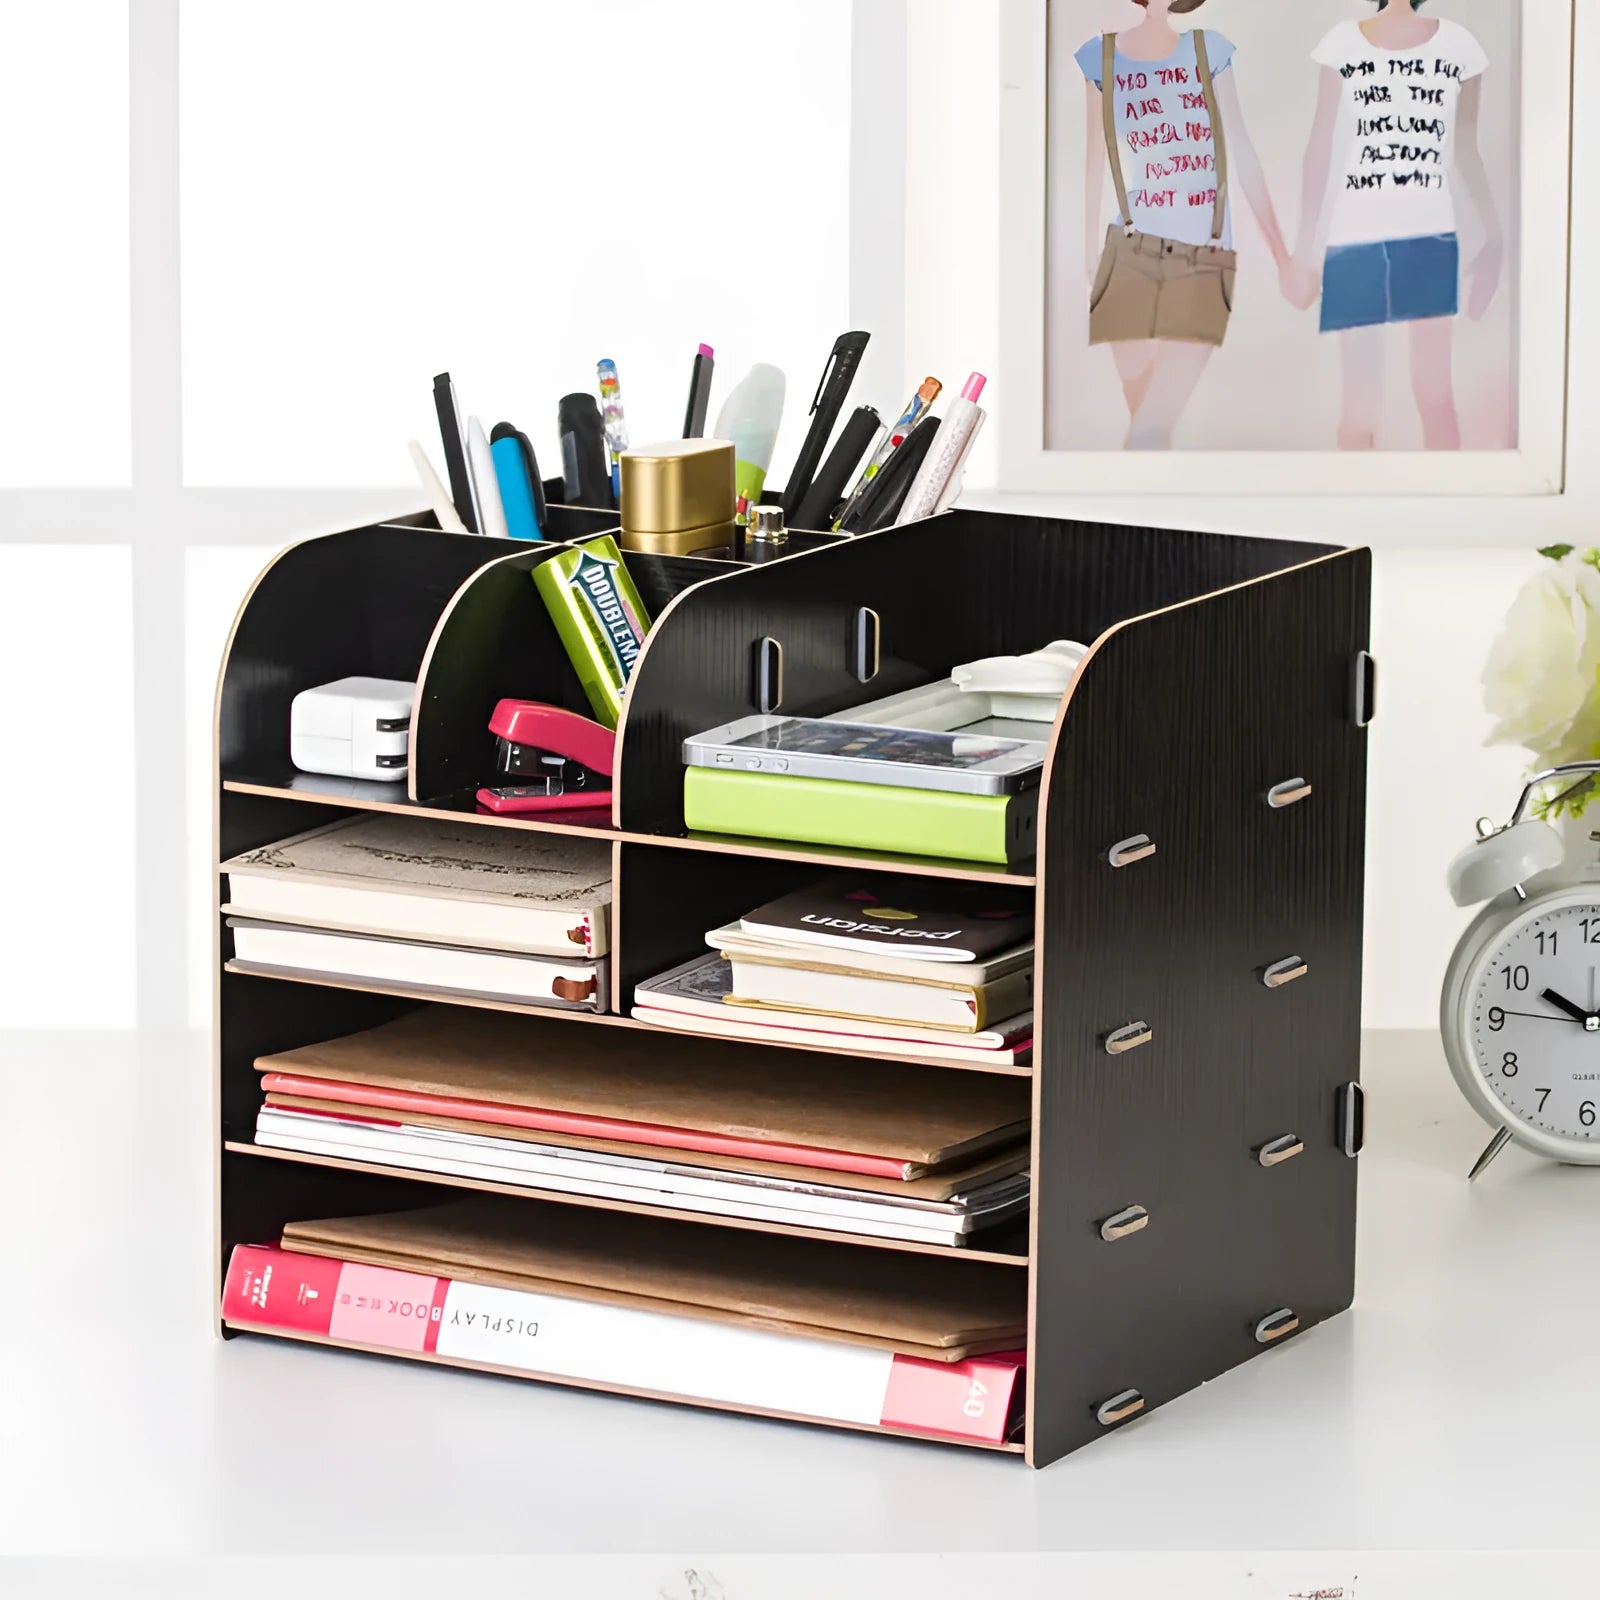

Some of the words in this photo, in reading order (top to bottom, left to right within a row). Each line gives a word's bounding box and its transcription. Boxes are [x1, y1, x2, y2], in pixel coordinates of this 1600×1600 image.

[1534, 930, 1557, 956] 11
[1579, 918, 1600, 943] 12
[1501, 965, 1529, 991] 10
[1488, 1006, 1505, 1031] 9
[1501, 1051, 1518, 1077] 8
[1535, 1088, 1551, 1112] 7
[1579, 1100, 1596, 1126] 6
[450, 1309, 539, 1337] DISPLAY
